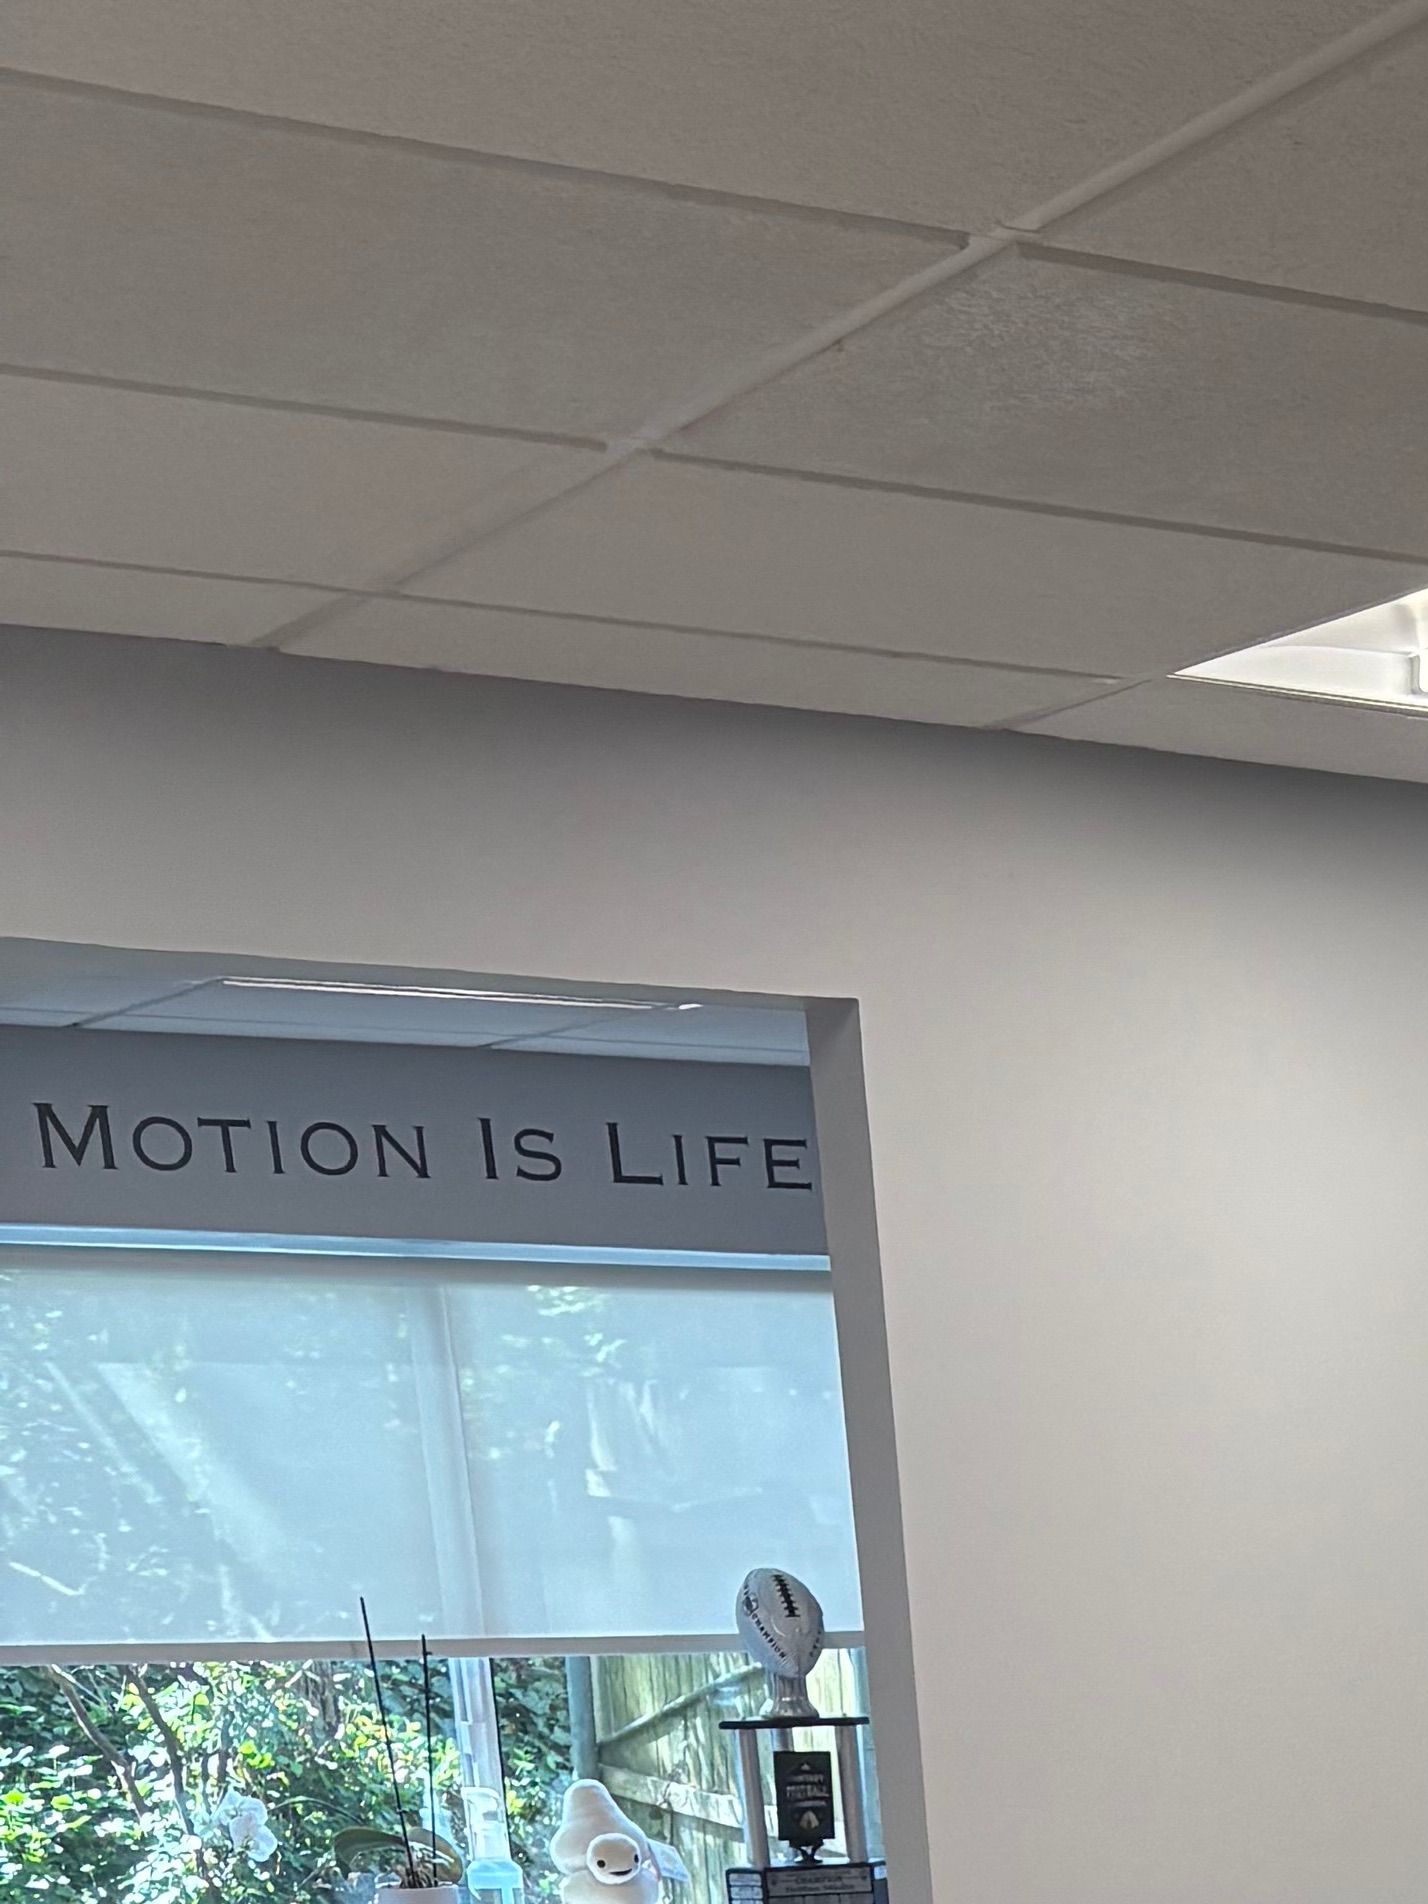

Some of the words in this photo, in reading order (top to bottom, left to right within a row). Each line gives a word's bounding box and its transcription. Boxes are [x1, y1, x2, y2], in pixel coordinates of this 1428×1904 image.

[32, 1102, 431, 1179] MOTION
[477, 1117, 562, 1182] IS
[605, 1122, 813, 1191] LIFE
